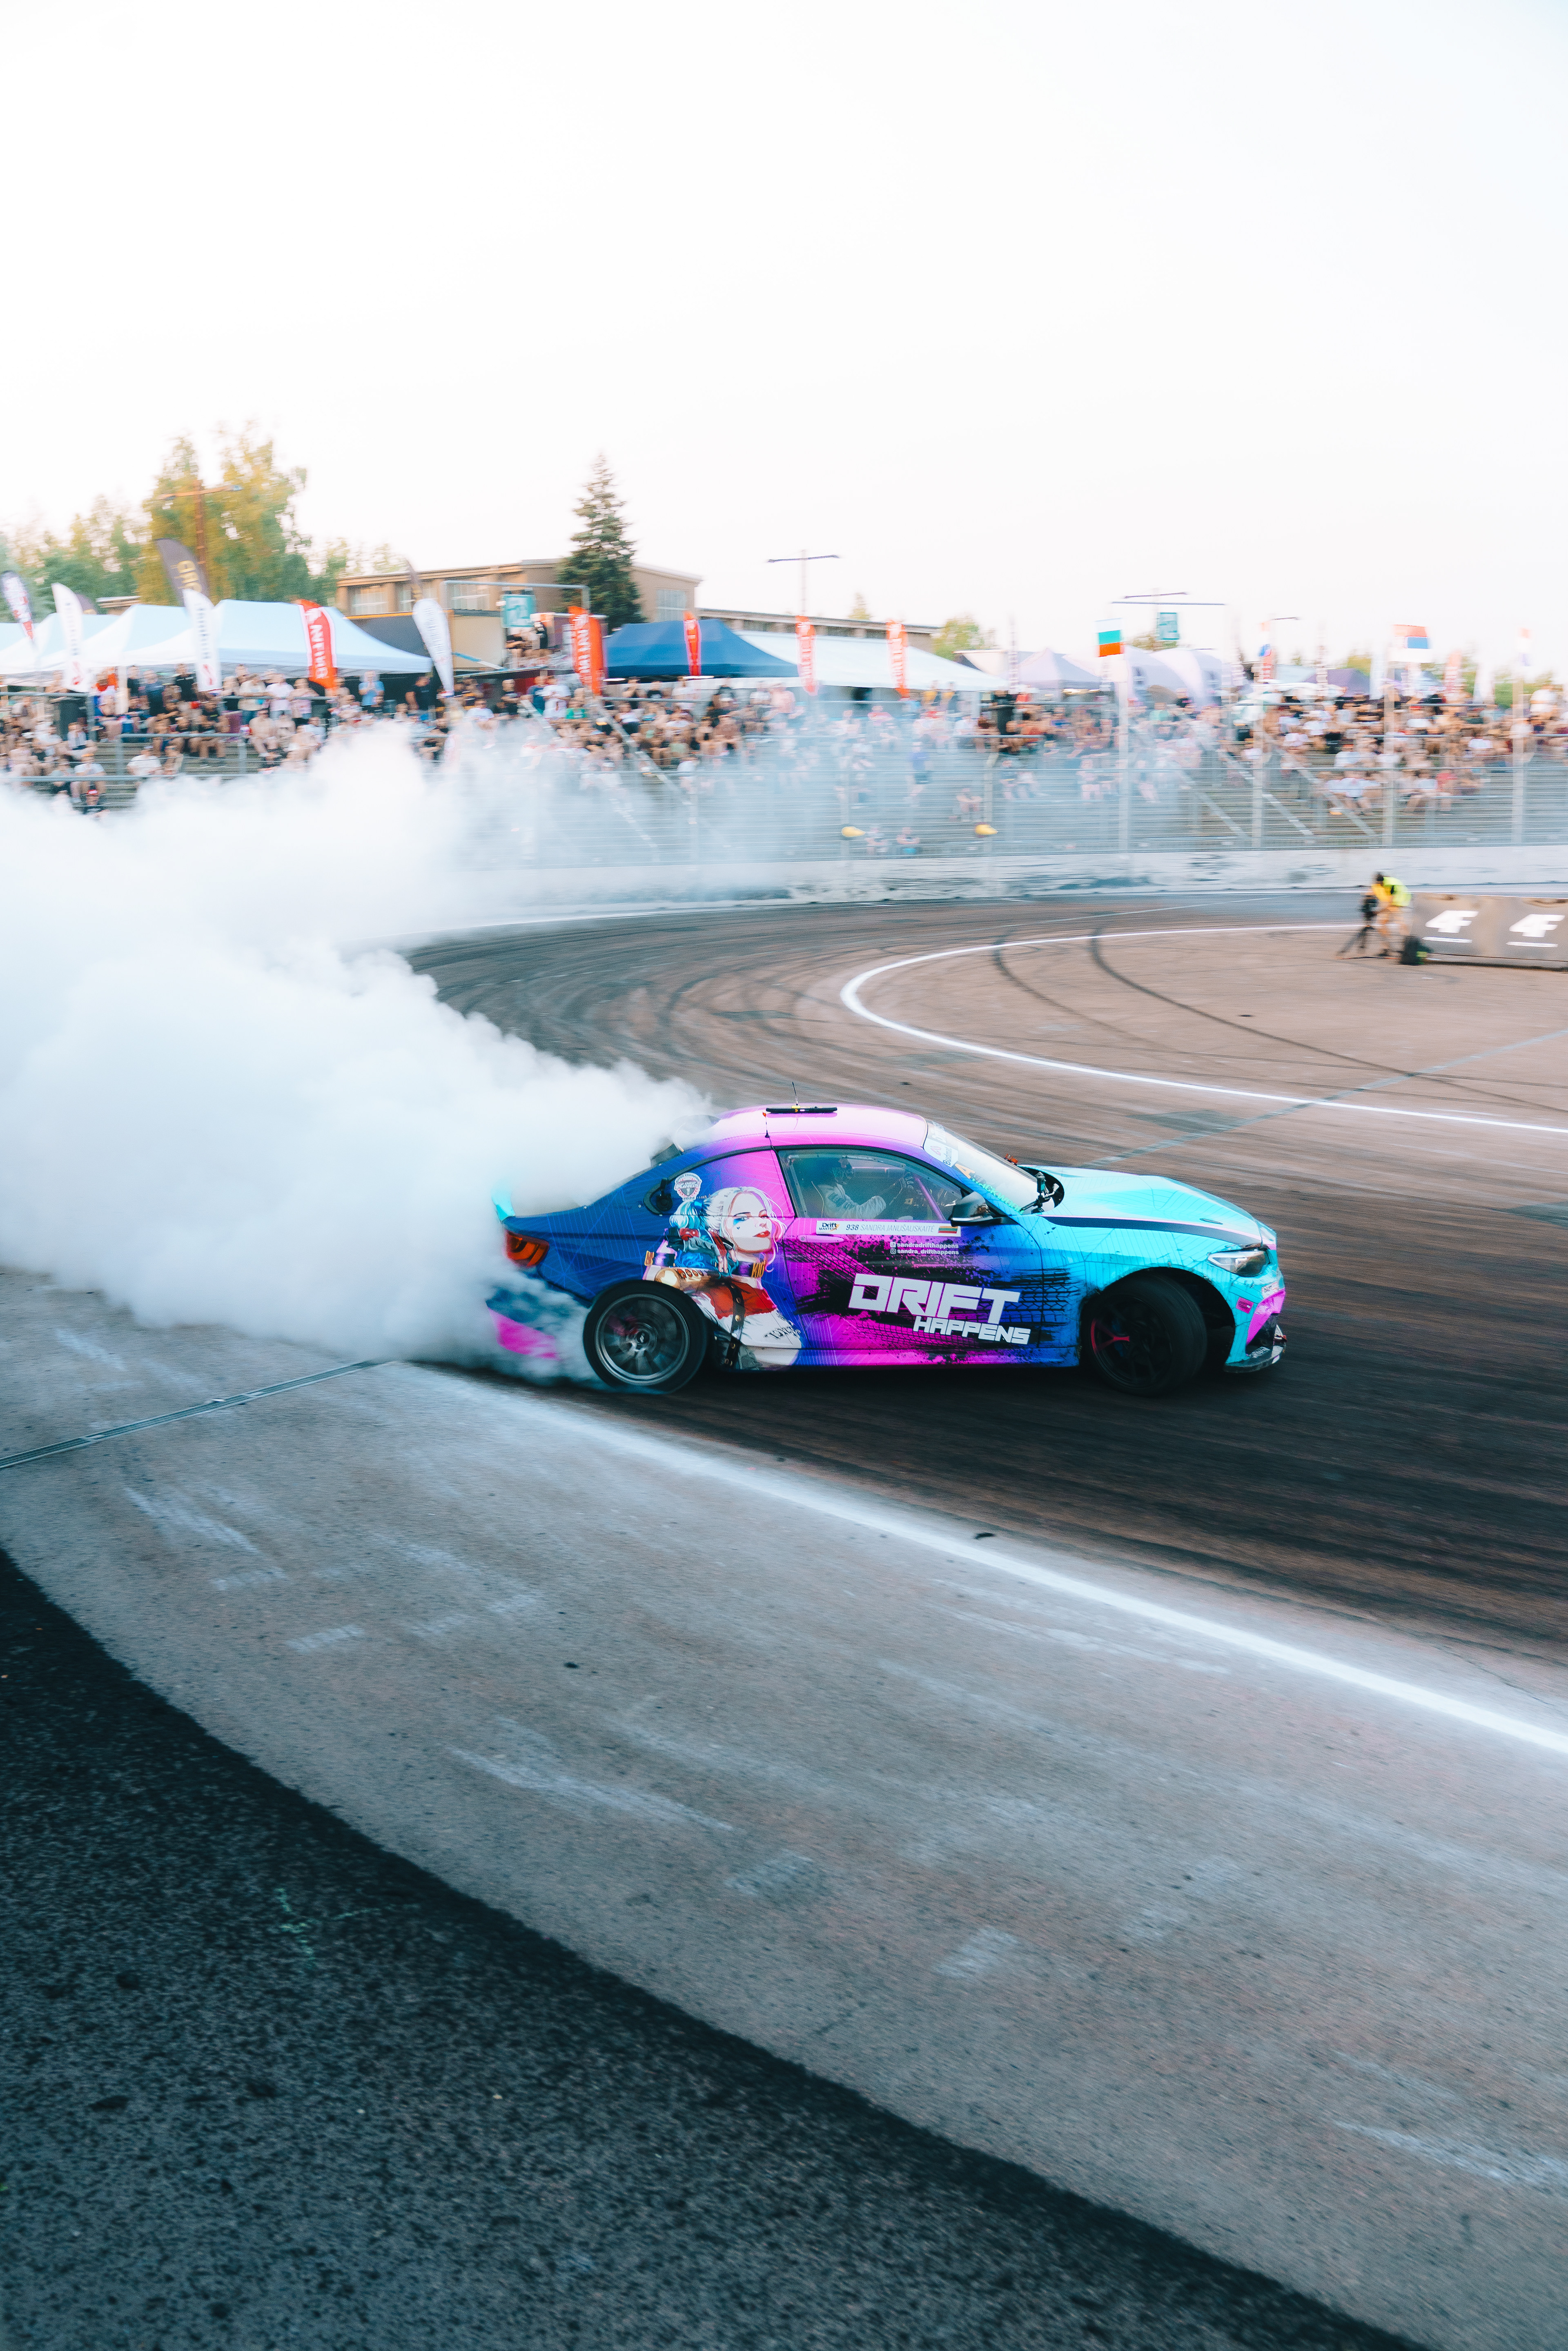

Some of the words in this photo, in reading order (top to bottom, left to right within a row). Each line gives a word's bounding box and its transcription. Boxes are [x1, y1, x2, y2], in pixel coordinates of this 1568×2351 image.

[942, 1146, 952, 1165] Budmat
[886, 1224, 935, 1232] JANUŠAUSKAITĖ
[849, 1273, 1020, 1325] DRIFT
[913, 1316, 1031, 1345] HAPPENS
